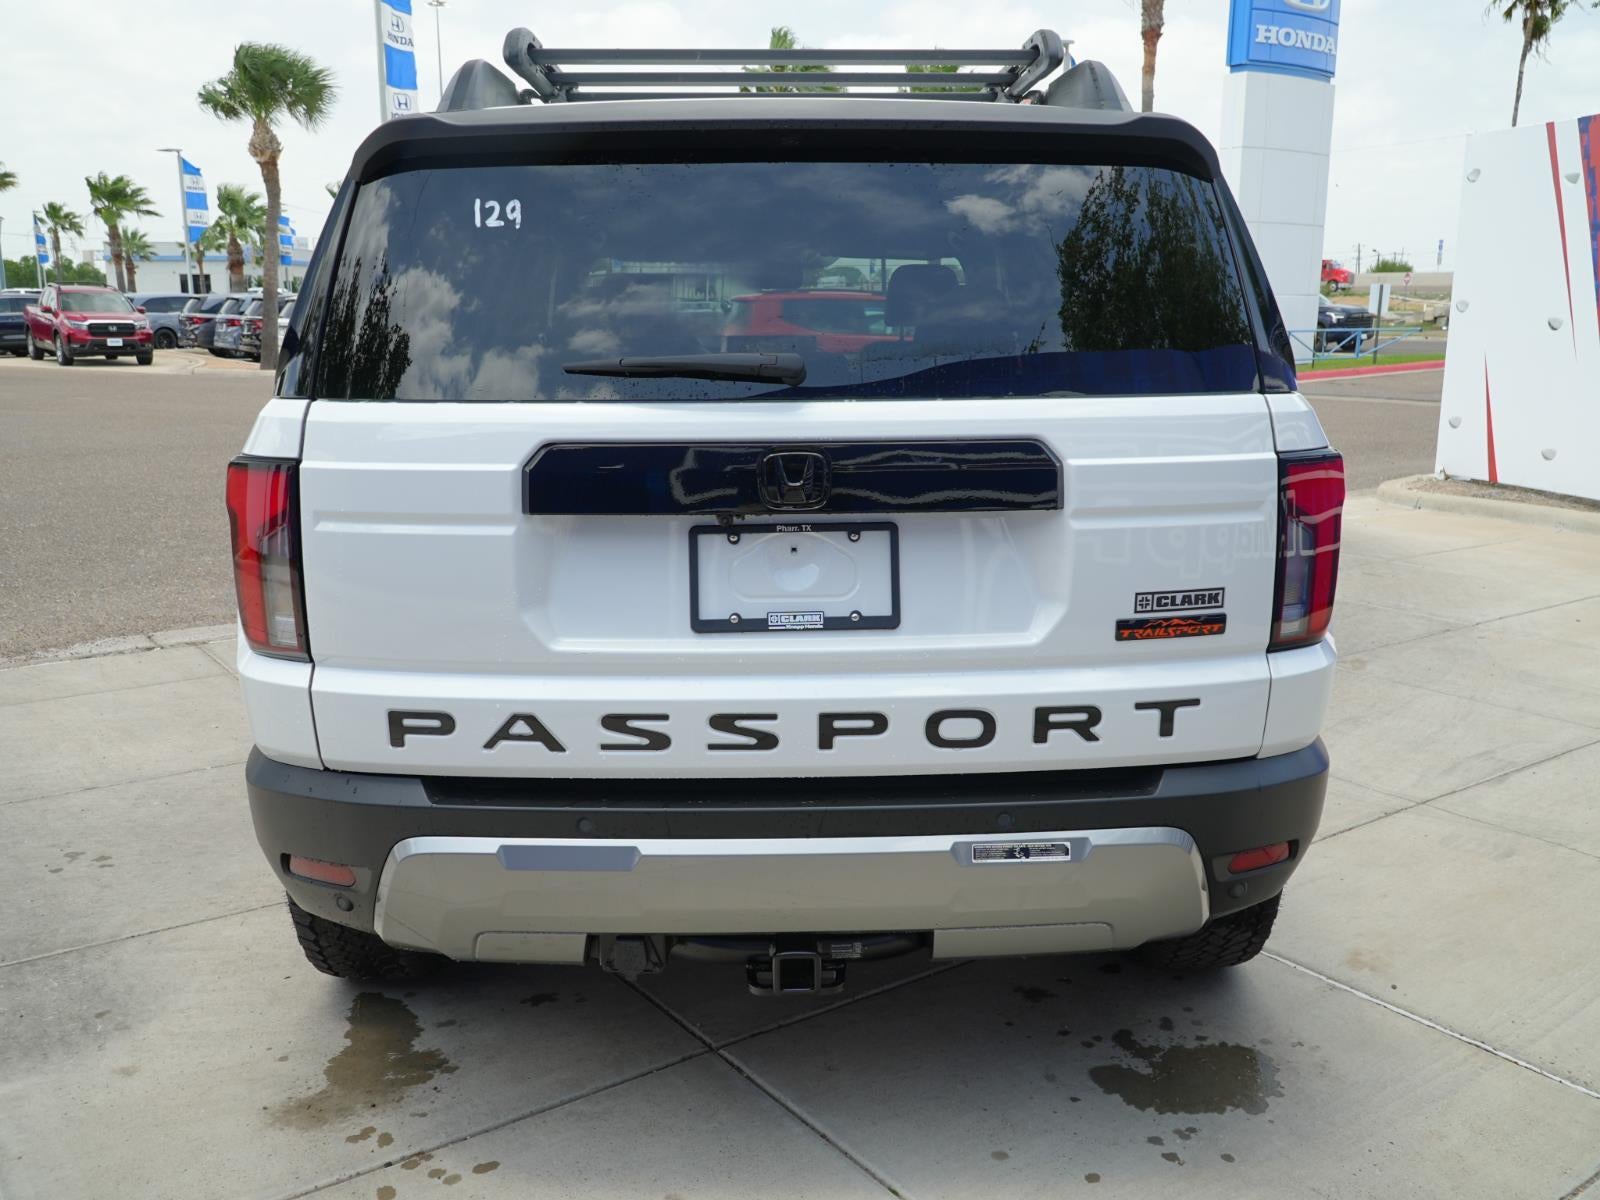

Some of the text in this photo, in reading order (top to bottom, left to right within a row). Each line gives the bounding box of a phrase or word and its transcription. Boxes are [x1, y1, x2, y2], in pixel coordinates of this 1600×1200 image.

[1256, 24, 1336, 56] HONDA
[474, 198, 521, 229] 129
[801, 524, 812, 532] TX
[1156, 592, 1220, 608] CLARK
[781, 615, 821, 623] CLARK
[1119, 623, 1223, 639] TRAILSPORT
[387, 699, 1200, 752] PASSPORT
